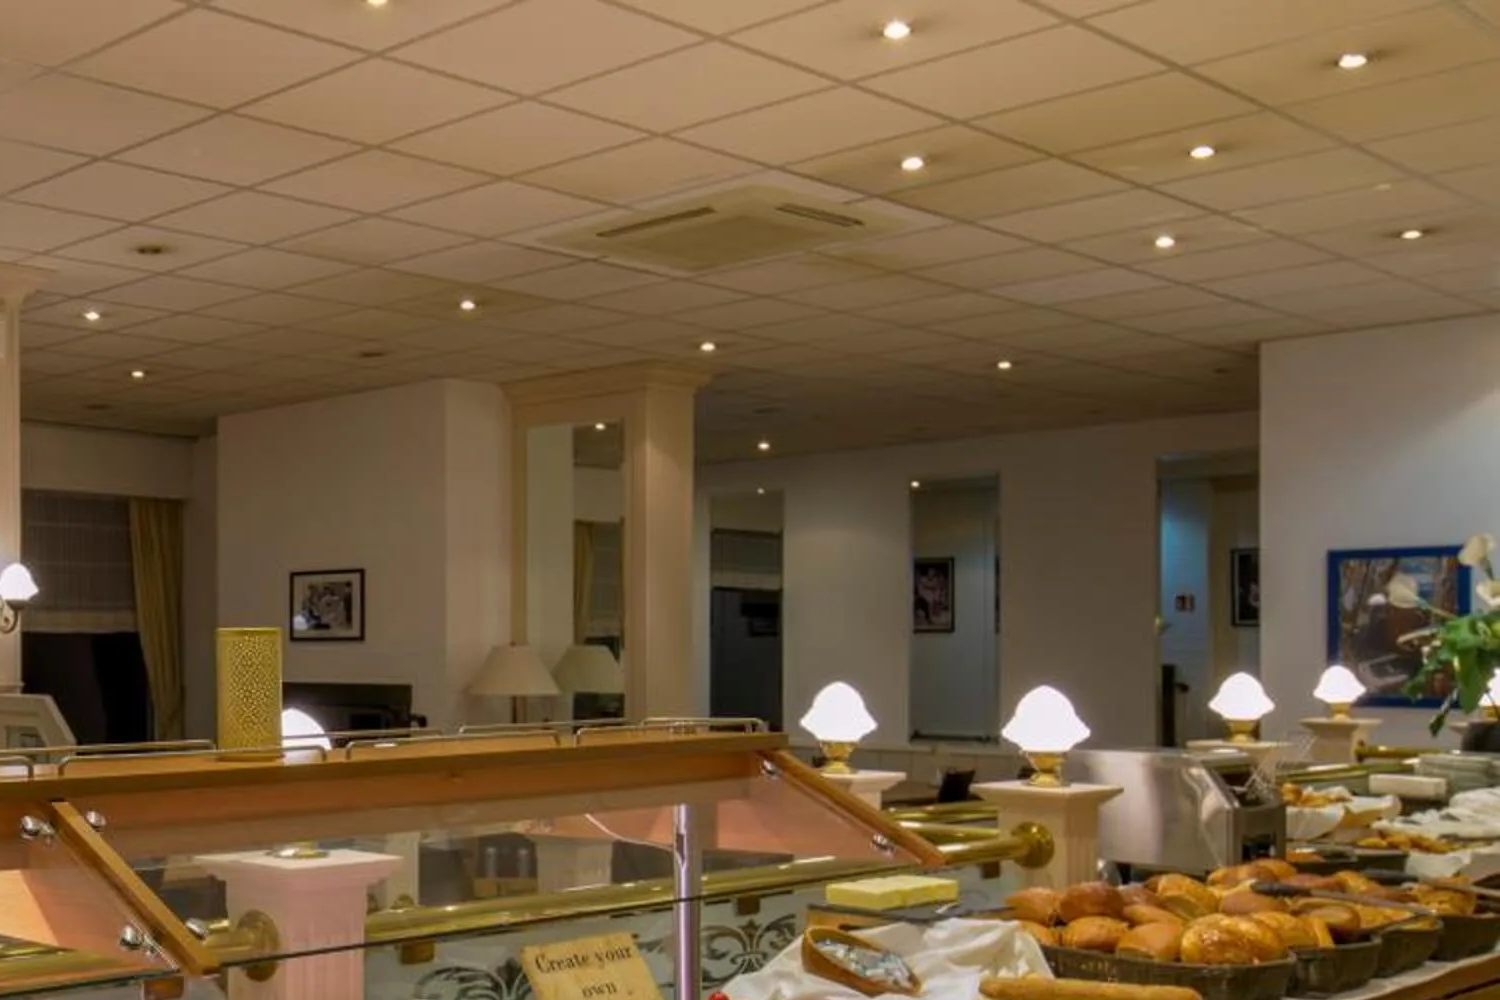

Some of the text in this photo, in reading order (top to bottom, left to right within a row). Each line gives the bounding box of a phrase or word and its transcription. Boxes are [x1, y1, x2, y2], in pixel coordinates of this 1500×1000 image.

[535, 946, 632, 974] Create your
[581, 981, 617, 998] own
